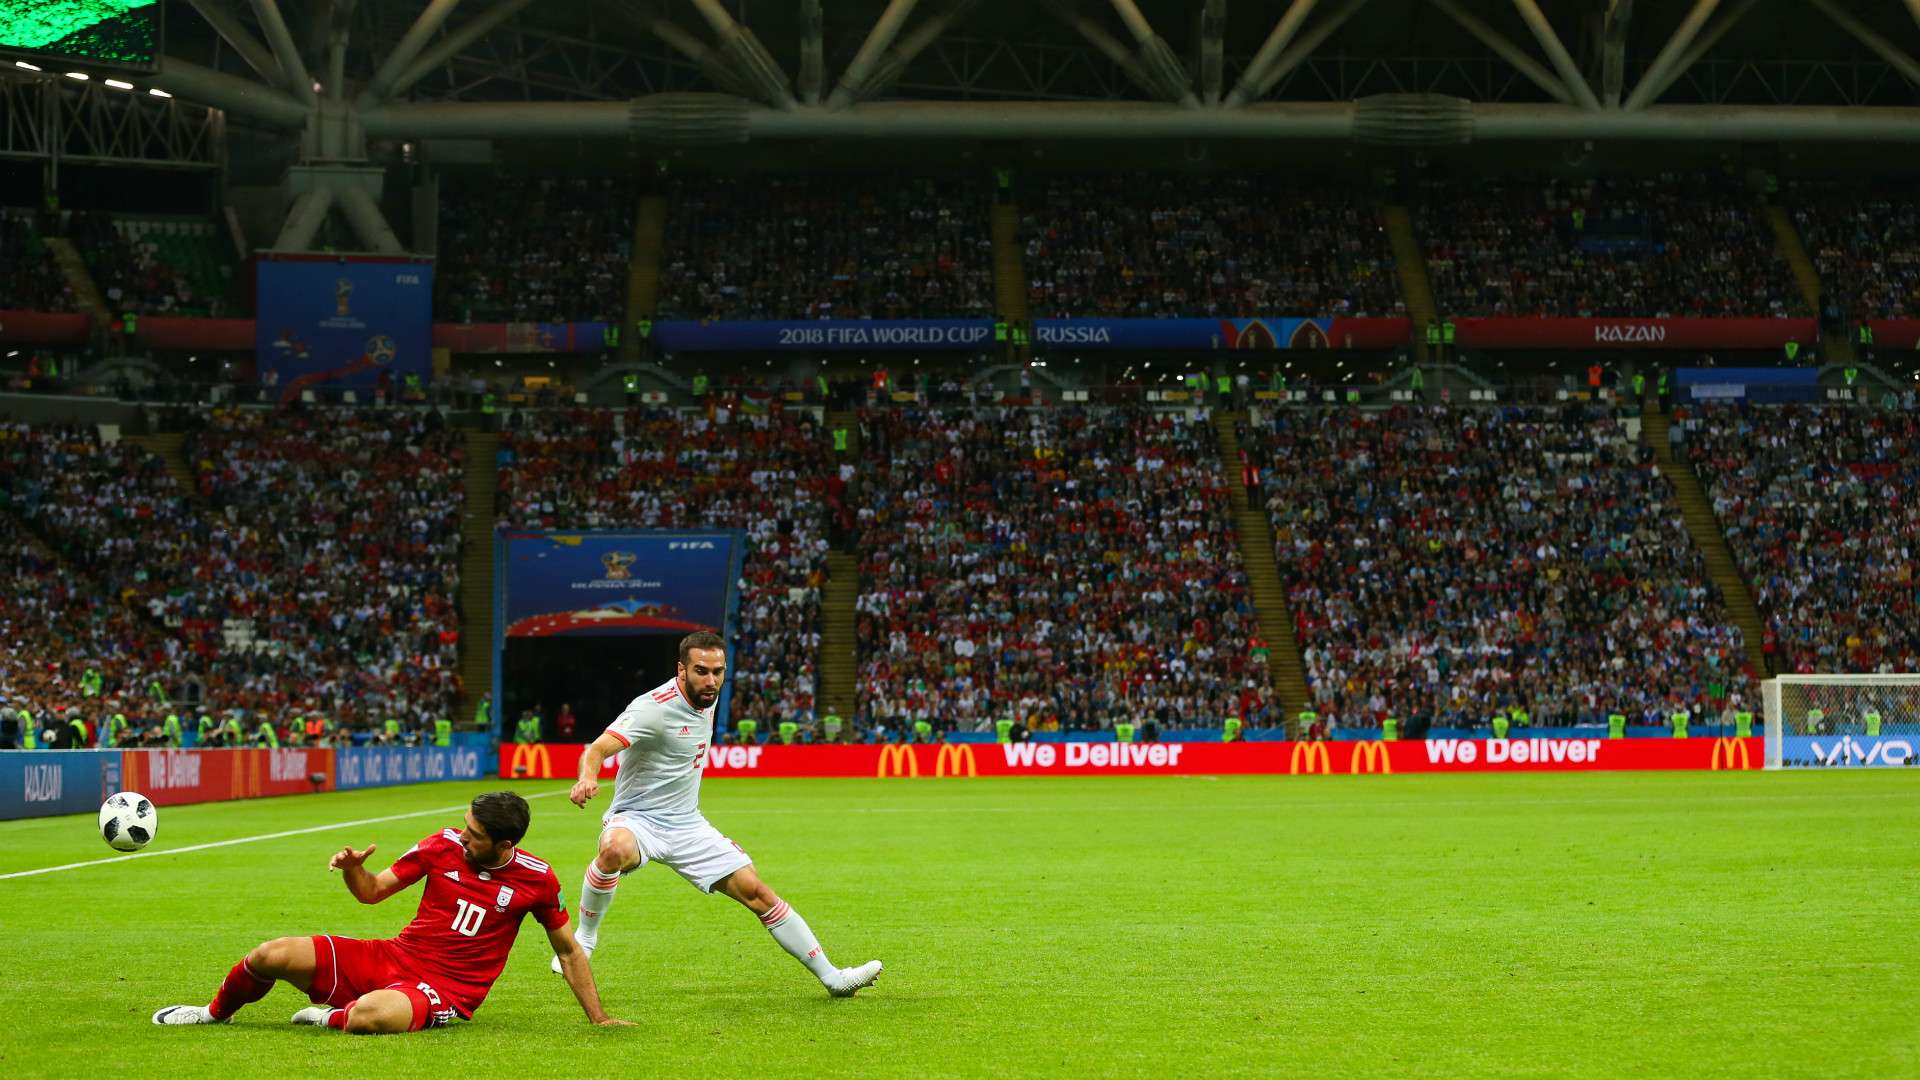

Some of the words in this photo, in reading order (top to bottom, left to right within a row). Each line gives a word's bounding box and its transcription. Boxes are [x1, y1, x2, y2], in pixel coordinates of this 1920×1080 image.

[779, 328, 824, 344] 2018
[828, 328, 868, 343] FIFA
[872, 327, 943, 343] WORLD
[947, 327, 988, 343] CUP
[1036, 326, 1110, 342] RUSSIA
[1594, 325, 1665, 342] KAZAN
[668, 541, 714, 550] FIFA
[692, 743, 706, 769] 2
[1003, 743, 1056, 767] We
[1065, 742, 1182, 767] Deliver
[1425, 739, 1477, 763] We
[1486, 738, 1600, 763] Deliver
[1810, 736, 1914, 766] vivo
[149, 750, 166, 789] We
[168, 750, 200, 787] Deliver
[24, 764, 62, 802] KAZAN
[450, 898, 487, 937] 10
